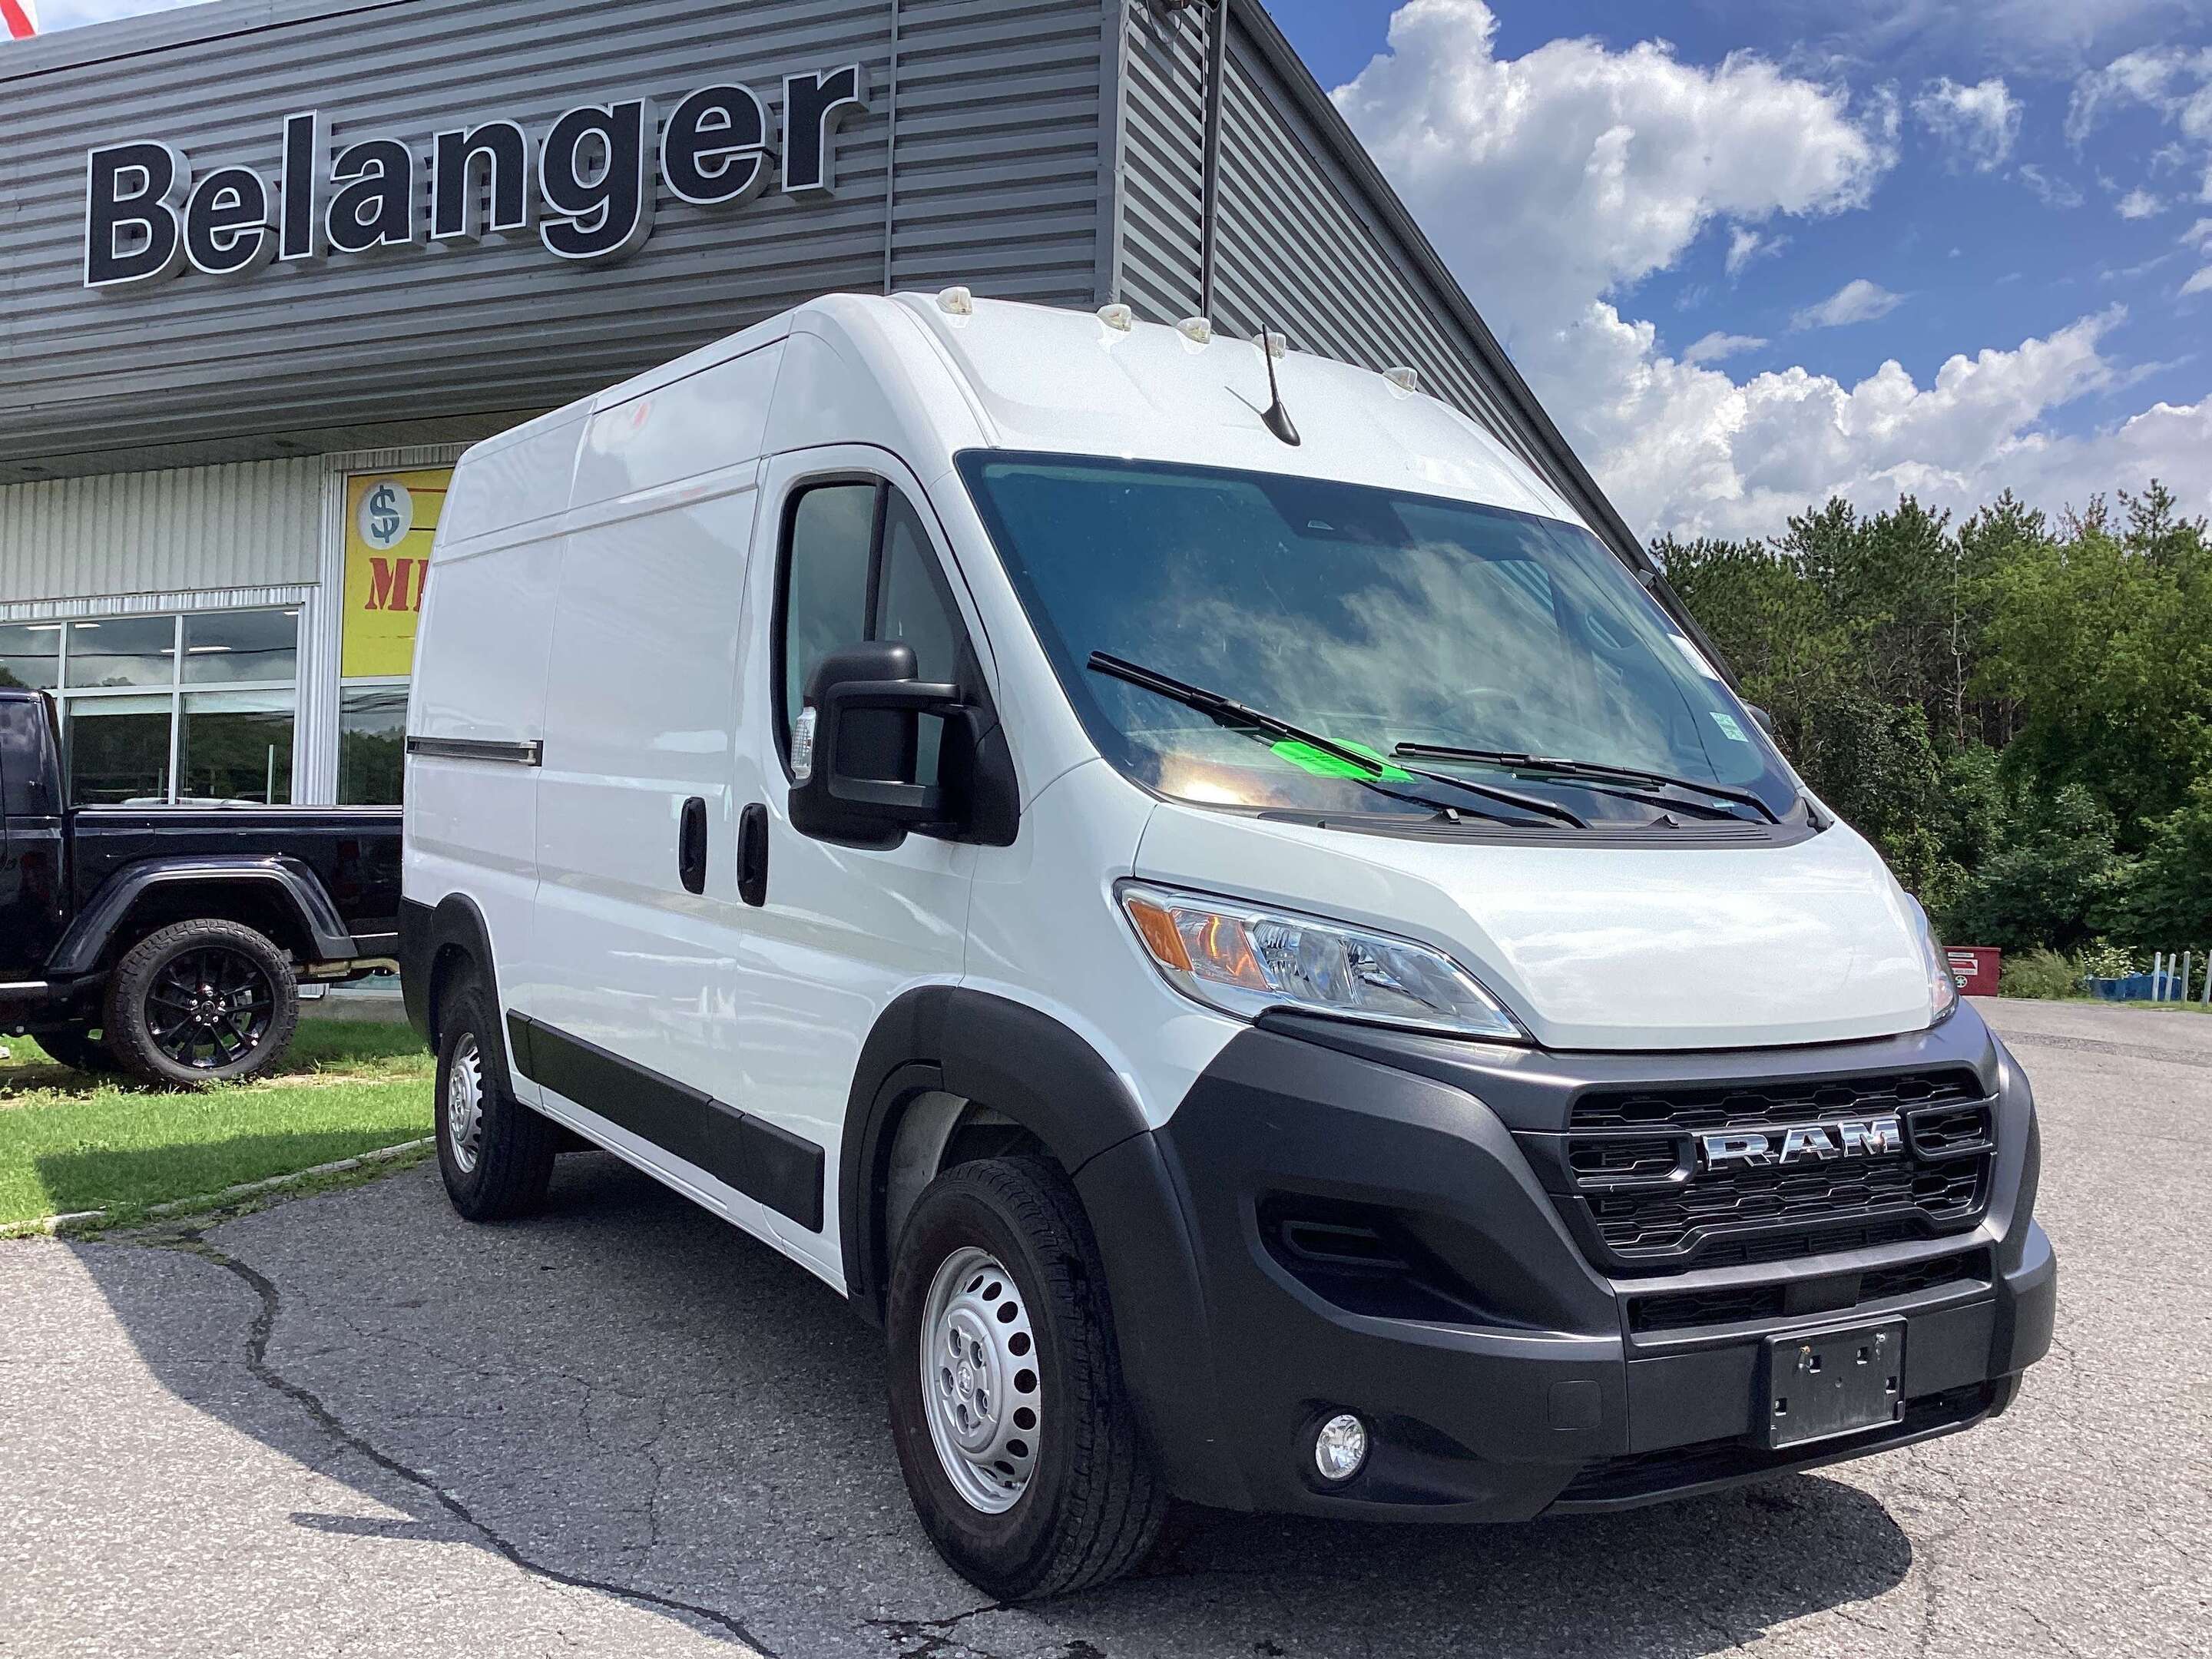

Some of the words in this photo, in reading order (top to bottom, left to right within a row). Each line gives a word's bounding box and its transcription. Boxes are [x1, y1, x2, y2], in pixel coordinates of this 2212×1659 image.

[84, 62, 869, 289] Belanger
[369, 485, 400, 544] $
[1700, 1120, 1902, 1171] RAM
